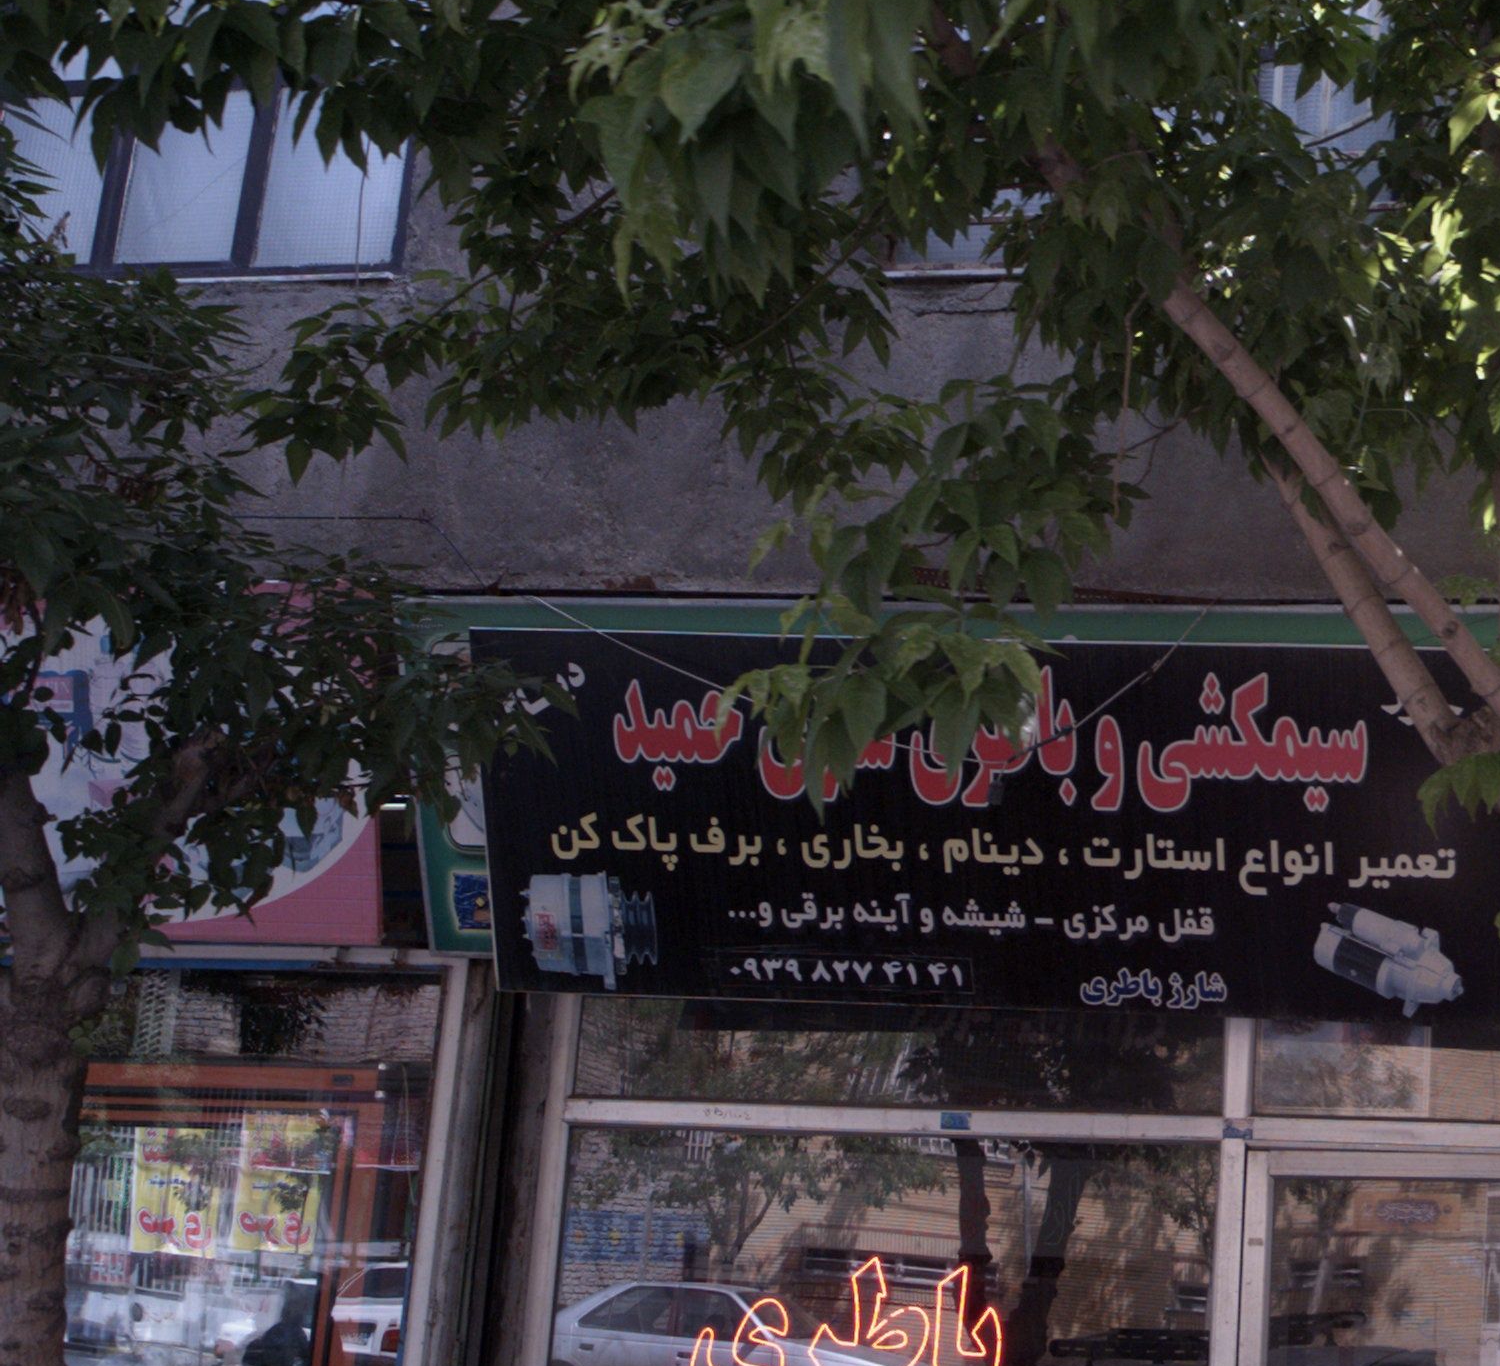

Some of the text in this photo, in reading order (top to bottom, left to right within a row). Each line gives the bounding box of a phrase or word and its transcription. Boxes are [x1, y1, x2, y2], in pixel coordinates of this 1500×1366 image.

[613, 678, 744, 792] حمید
[1135, 671, 1369, 814] سیمکشی
[1092, 715, 1125, 811] و
[551, 812, 600, 860] کن
[611, 813, 680, 871] پاک
[689, 816, 762, 865] برف
[801, 823, 904, 870] بخاری
[943, 828, 1044, 875] دینام
[1083, 834, 1225, 880] استارت
[1238, 840, 1334, 895] انواع
[1348, 848, 1456, 889] تعمیر
[781, 892, 844, 930] برقی
[853, 893, 911, 932] آینه
[920, 907, 934, 933] و
[942, 898, 1026, 936] شیشه
[1063, 904, 1149, 941] مرکزی
[1158, 907, 1215, 943] قفل
[729, 957, 964, 987] ۰۹۳۹ ۸۲۷ ۴۱ ۴۱
[1080, 967, 1228, 1010] شارژ باطری
